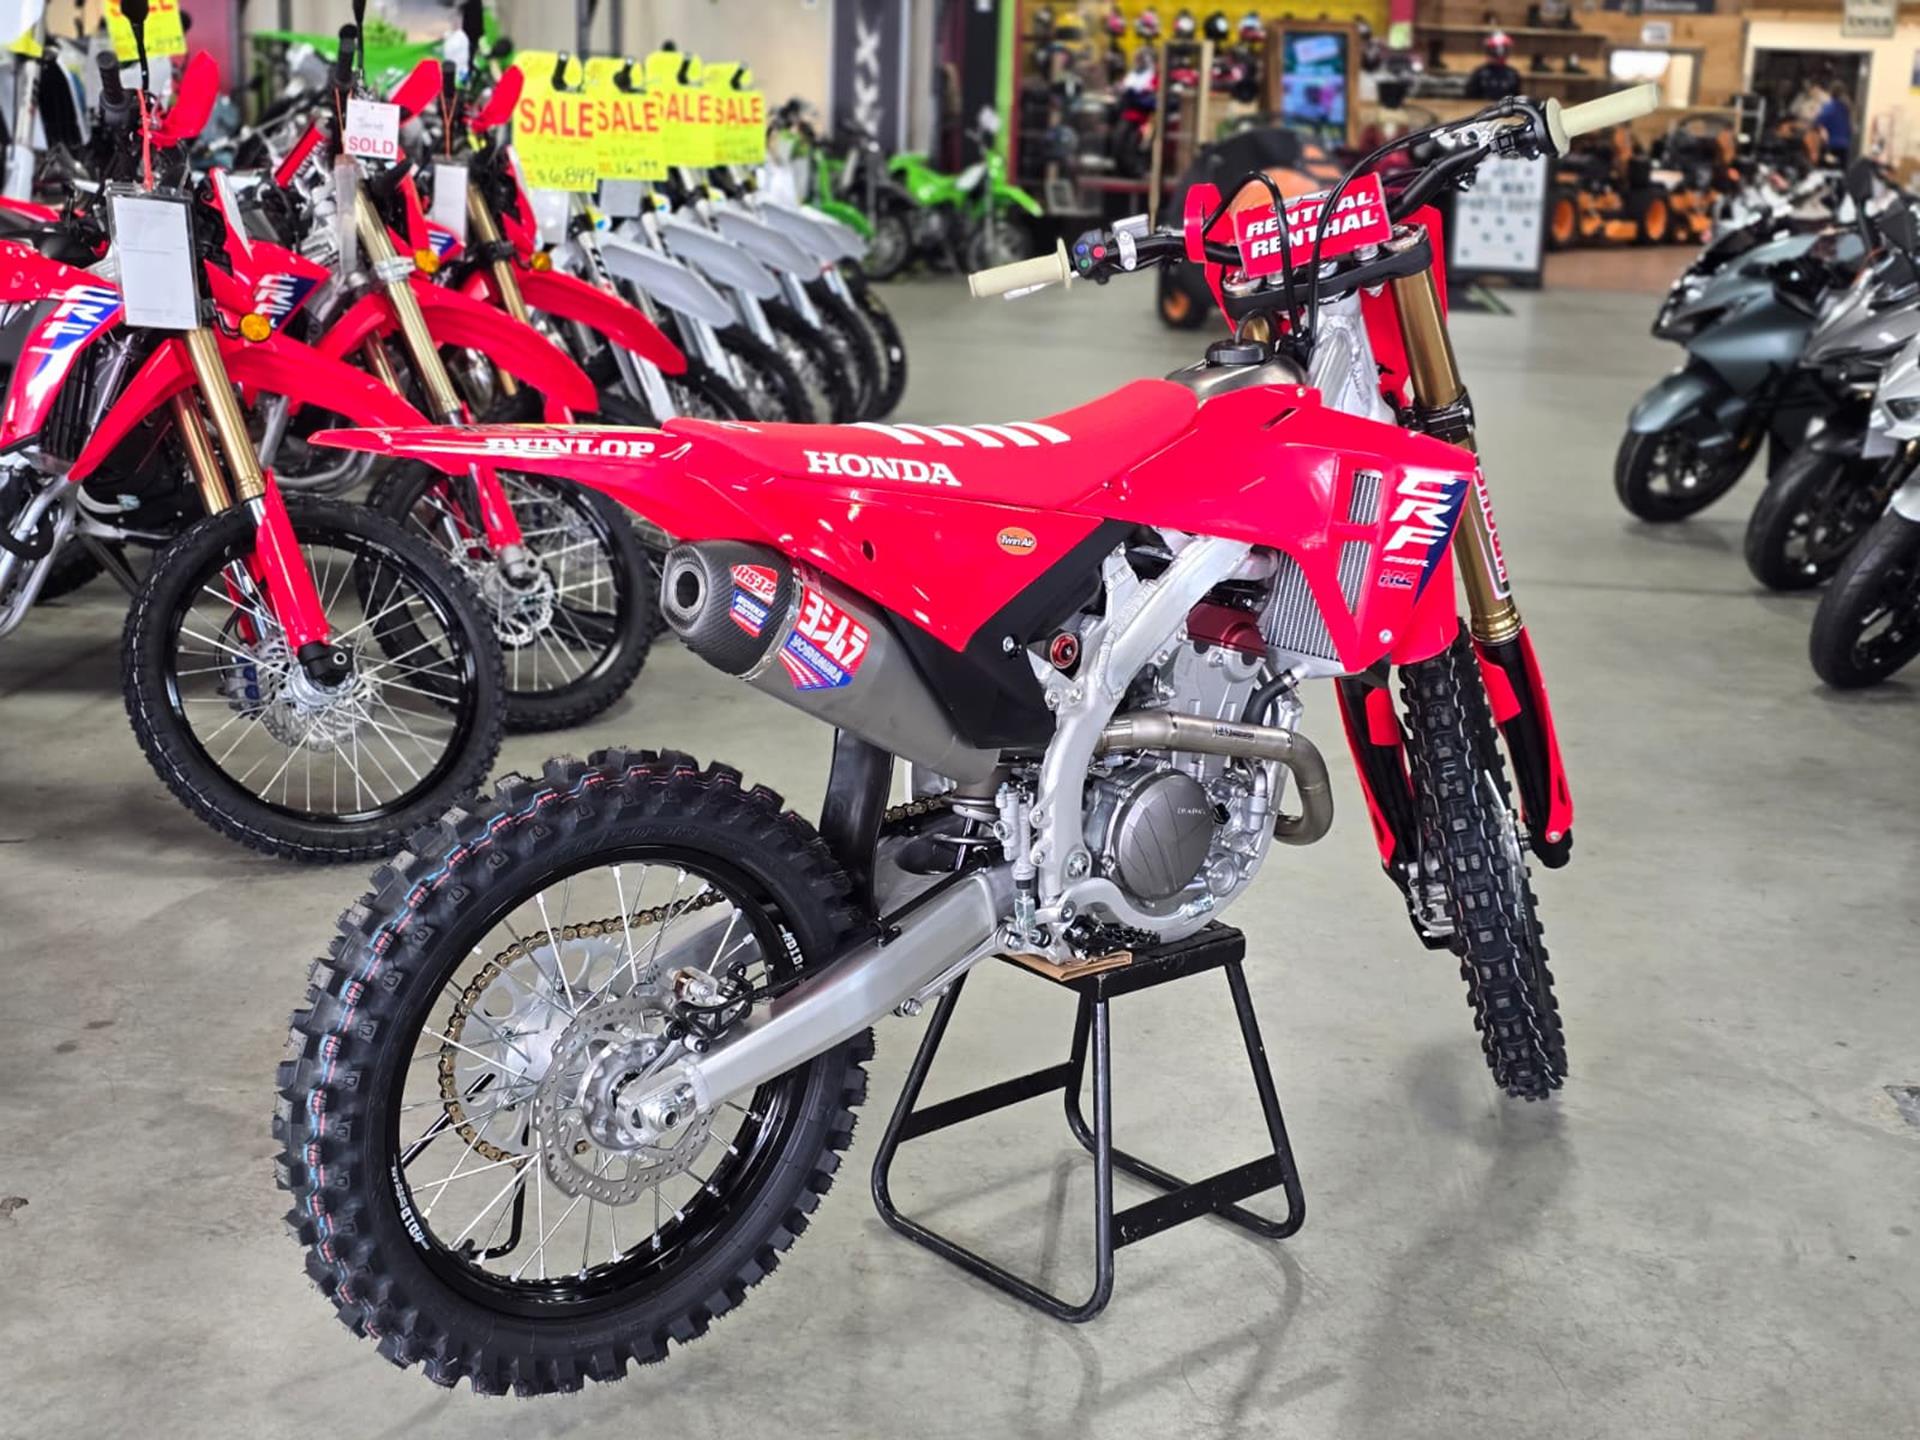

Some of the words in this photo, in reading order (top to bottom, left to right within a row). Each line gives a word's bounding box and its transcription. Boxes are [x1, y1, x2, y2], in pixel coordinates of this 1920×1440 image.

[519, 98, 594, 138] SALE
[597, 101, 659, 132] SALE
[348, 135, 394, 155] SOLD
[485, 438, 655, 458] DUNLOP
[803, 450, 963, 487] HONDA
[1384, 469, 1458, 551] CRF
[1000, 534, 1021, 546] Twin
[797, 591, 868, 666] ヨシムラ
[789, 634, 844, 684] YOSHIMURA
